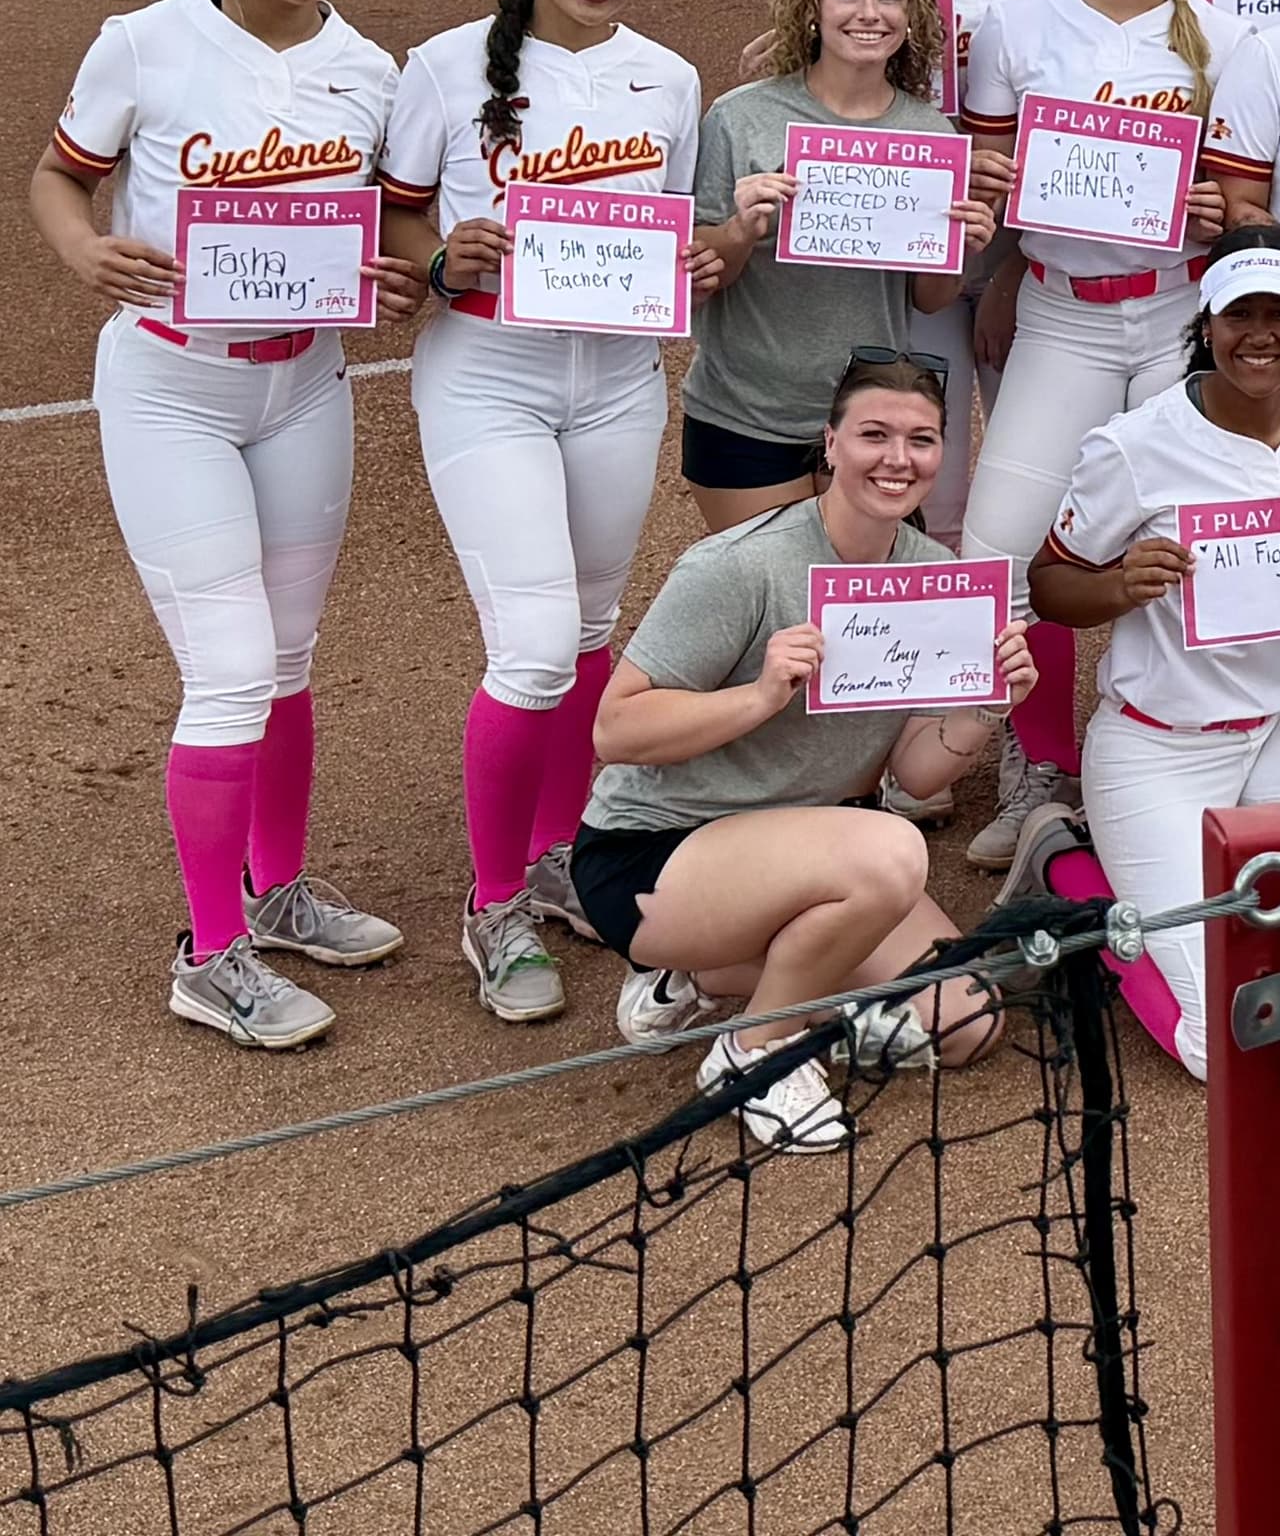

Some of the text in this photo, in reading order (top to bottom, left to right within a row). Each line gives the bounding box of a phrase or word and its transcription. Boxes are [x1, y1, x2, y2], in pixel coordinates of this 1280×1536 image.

[1034, 106, 1181, 144] I PLAY FOR...
[179, 126, 363, 188] Cyclones
[489, 126, 663, 188] Cyclones
[800, 137, 952, 164] I PLAY FOR...
[1066, 144, 1120, 173] AUNT
[807, 166, 911, 188] EVERYONE
[1051, 170, 1123, 198] RHENEA
[192, 200, 361, 219] I PLAY FOR...
[519, 196, 676, 226] I PLAY FOR...
[803, 188, 919, 212] AFFECTED BY
[800, 212, 874, 231] BREAST
[523, 234, 644, 267] My 5th grade
[794, 236, 864, 255] CANCER
[201, 244, 285, 278] Tasha
[539, 268, 613, 290] Teacher
[1192, 515, 1203, 533] I
[1214, 510, 1273, 532] PLAY
[1214, 544, 1240, 569] All
[825, 573, 993, 597] I PLAY FOR...
[842, 613, 891, 639] Auntie
[883, 640, 920, 667] Amy
[832, 673, 893, 695] Grandma
